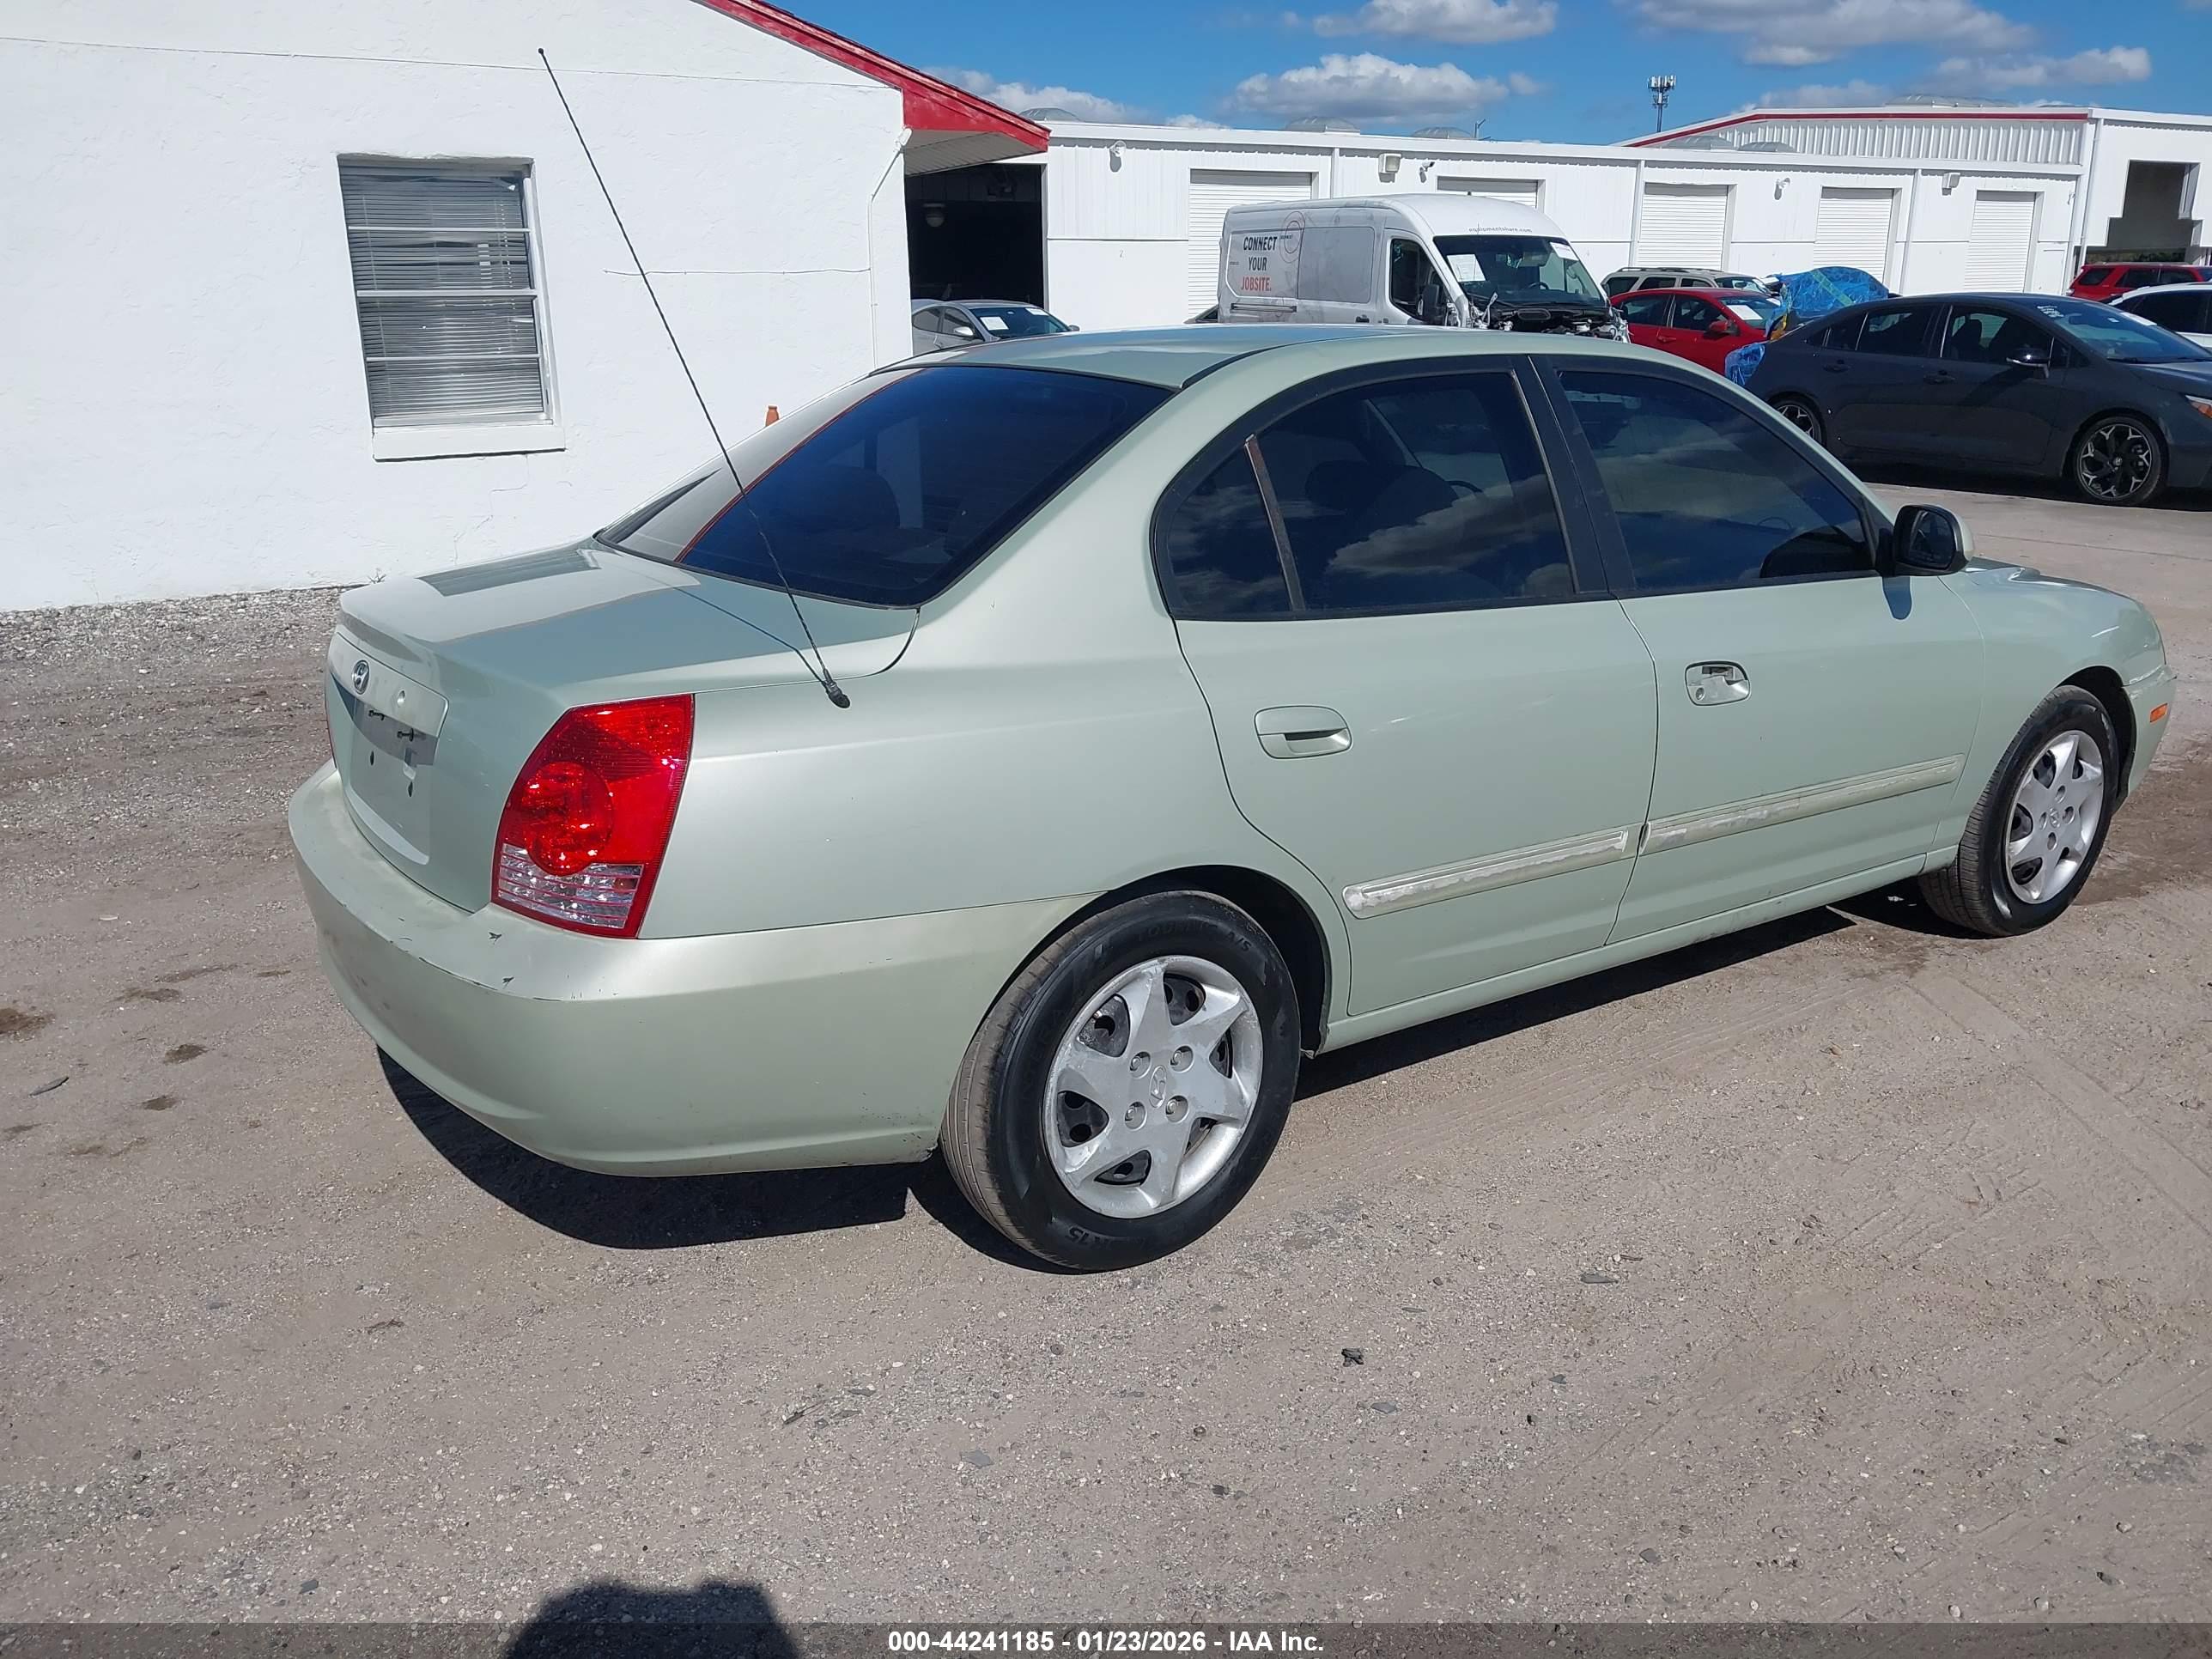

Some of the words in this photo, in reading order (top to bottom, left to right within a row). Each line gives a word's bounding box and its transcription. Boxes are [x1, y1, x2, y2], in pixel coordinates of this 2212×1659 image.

[1243, 236, 1277, 251] CONNECT
[1248, 256, 1267, 271] YOUR
[1241, 276, 1272, 292] JOBSITE.
